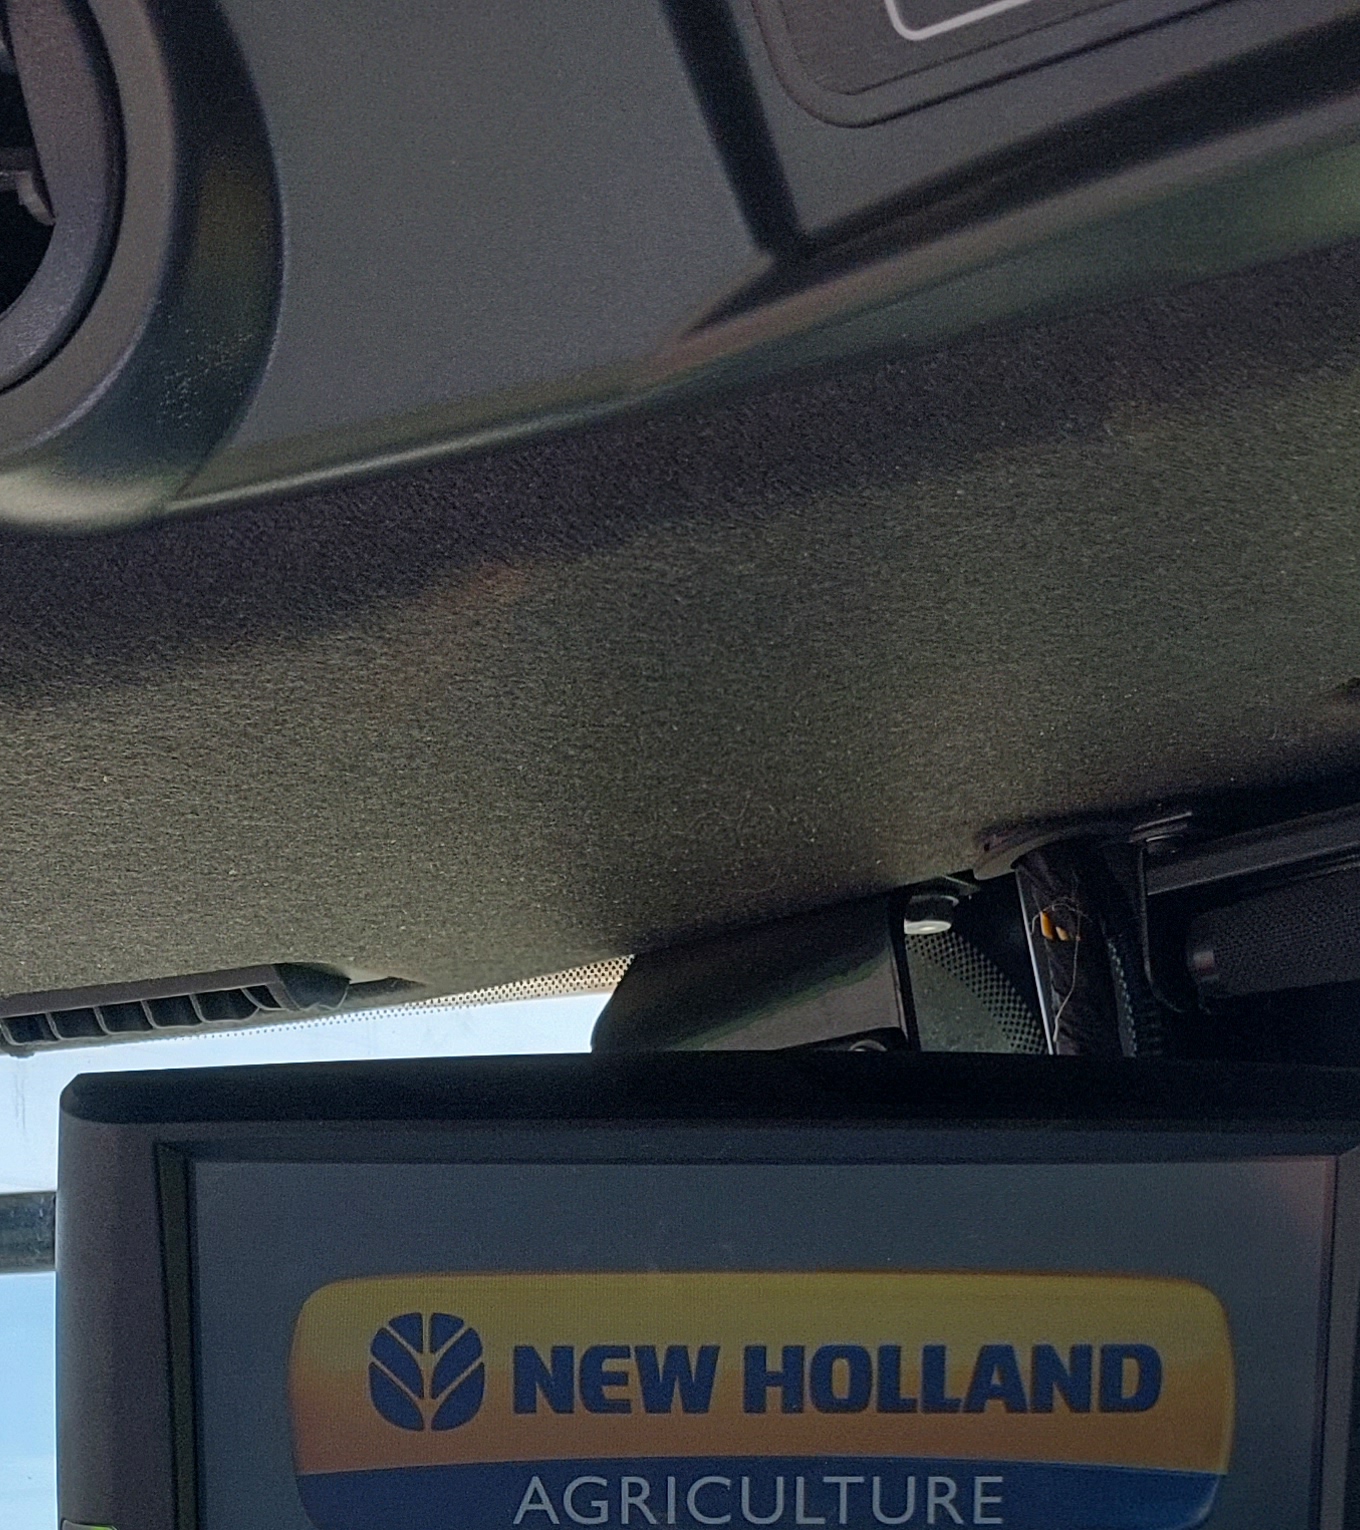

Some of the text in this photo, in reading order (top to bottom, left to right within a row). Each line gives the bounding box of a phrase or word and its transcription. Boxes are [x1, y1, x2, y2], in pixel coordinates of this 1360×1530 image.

[513, 1343, 1162, 1414] NEW HOLLAND
[513, 1476, 1004, 1525] AGRICULTURE
